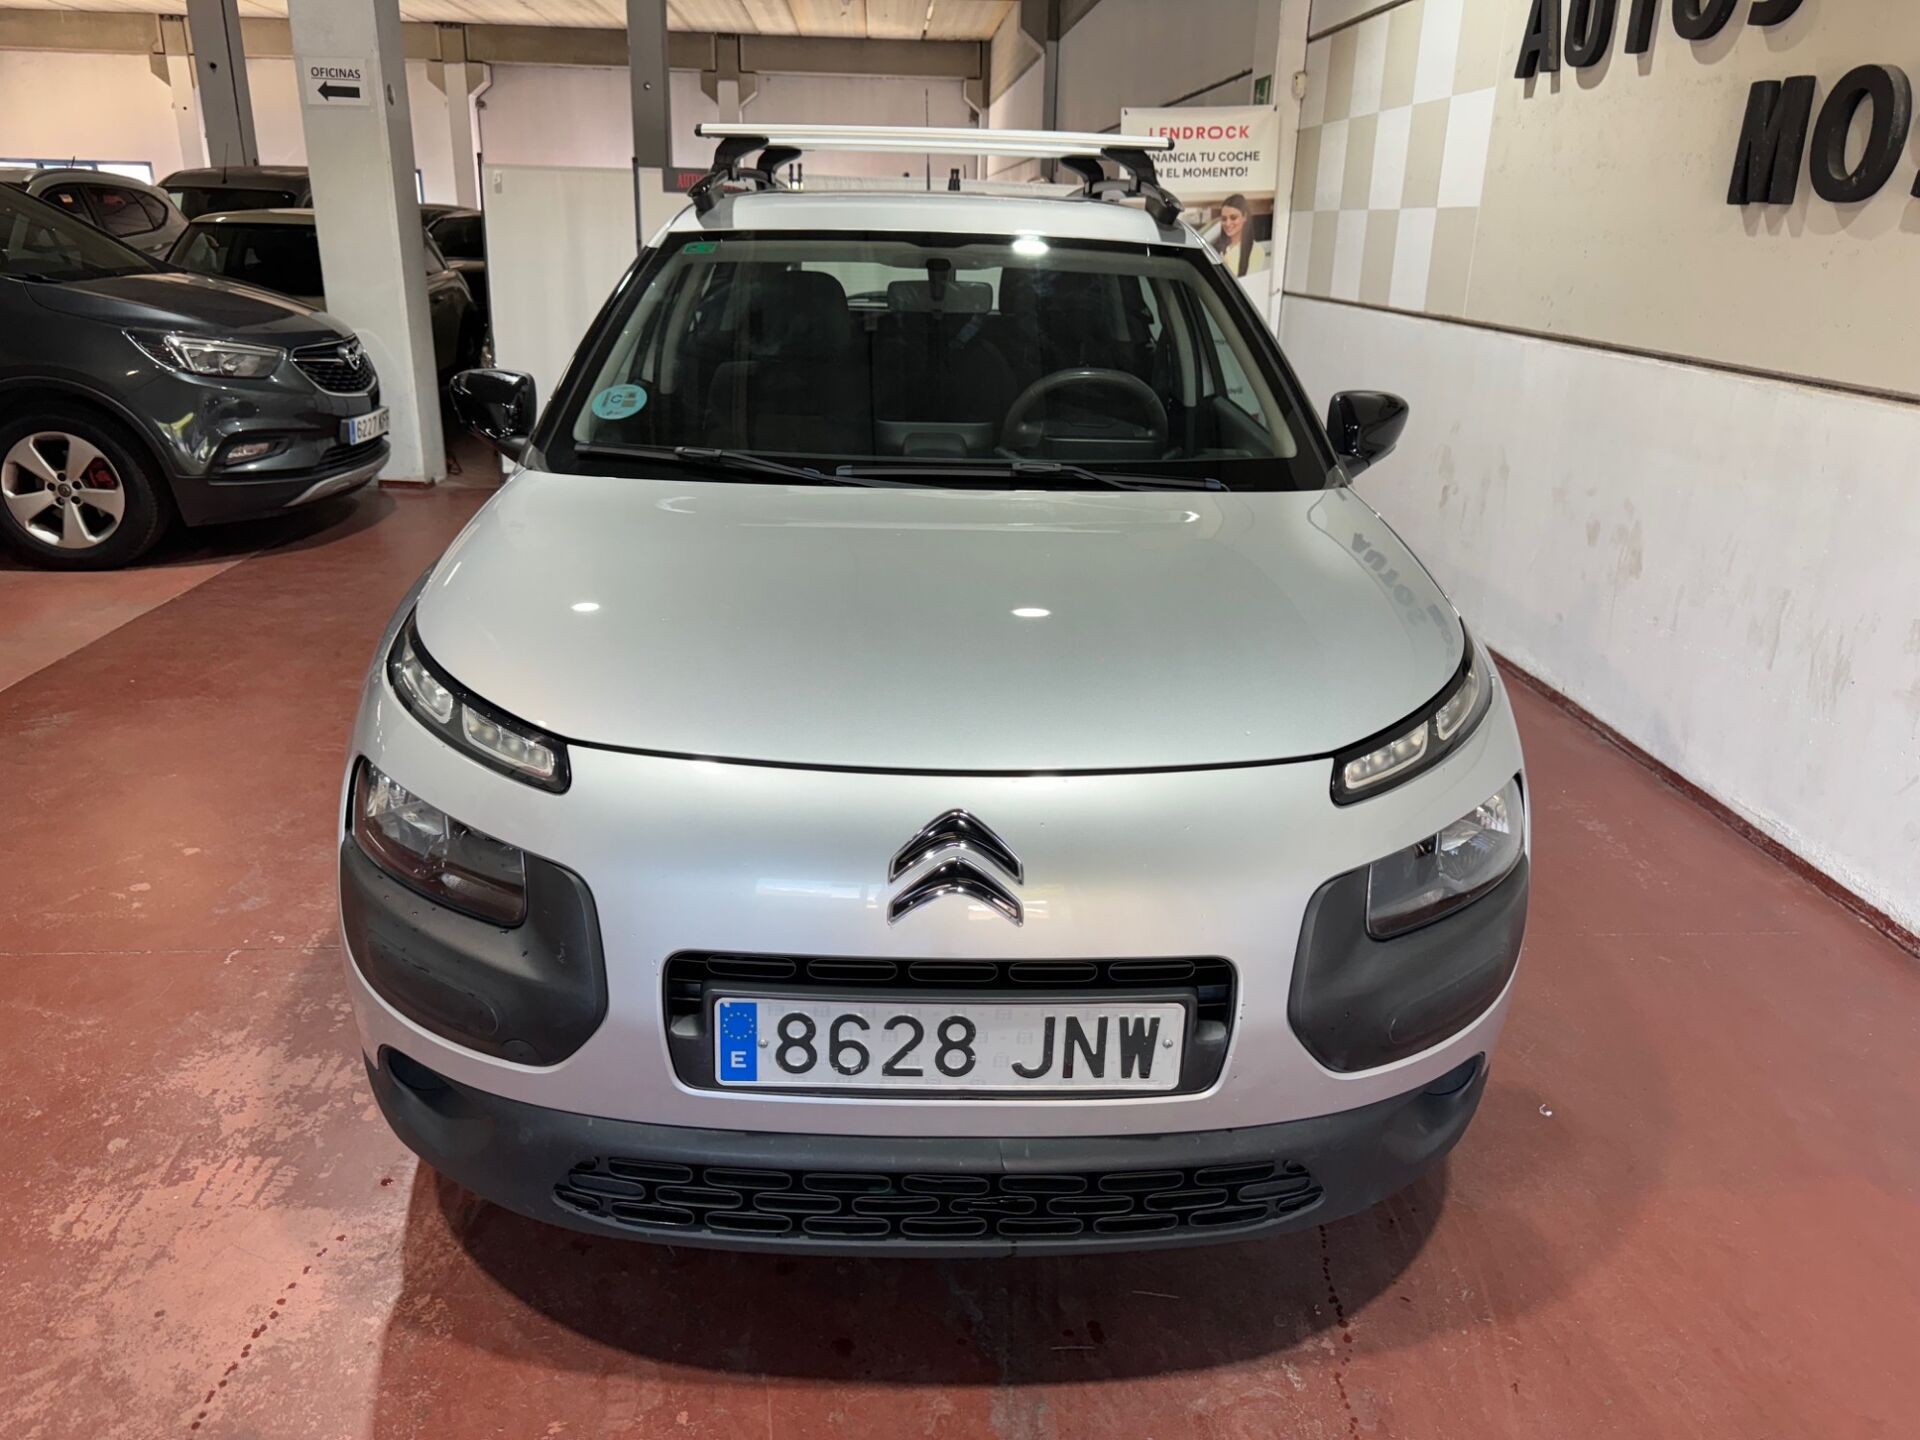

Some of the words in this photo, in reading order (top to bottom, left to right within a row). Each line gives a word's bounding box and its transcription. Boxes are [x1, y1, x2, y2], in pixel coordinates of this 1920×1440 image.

[311, 66, 361, 79] OFICINAS
[1149, 125, 1250, 140] LENDROCK
[1727, 64, 1920, 204] MO
[1150, 152, 1197, 164] NANCIA
[1200, 152, 1215, 162] TU
[1218, 151, 1260, 162] COCHE
[1166, 167, 1180, 178] EL
[1182, 166, 1248, 178] MOMENTO!
[775, 1012, 977, 1078] 8628
[1011, 1016, 1160, 1078] JNW
[730, 1050, 747, 1068] E
